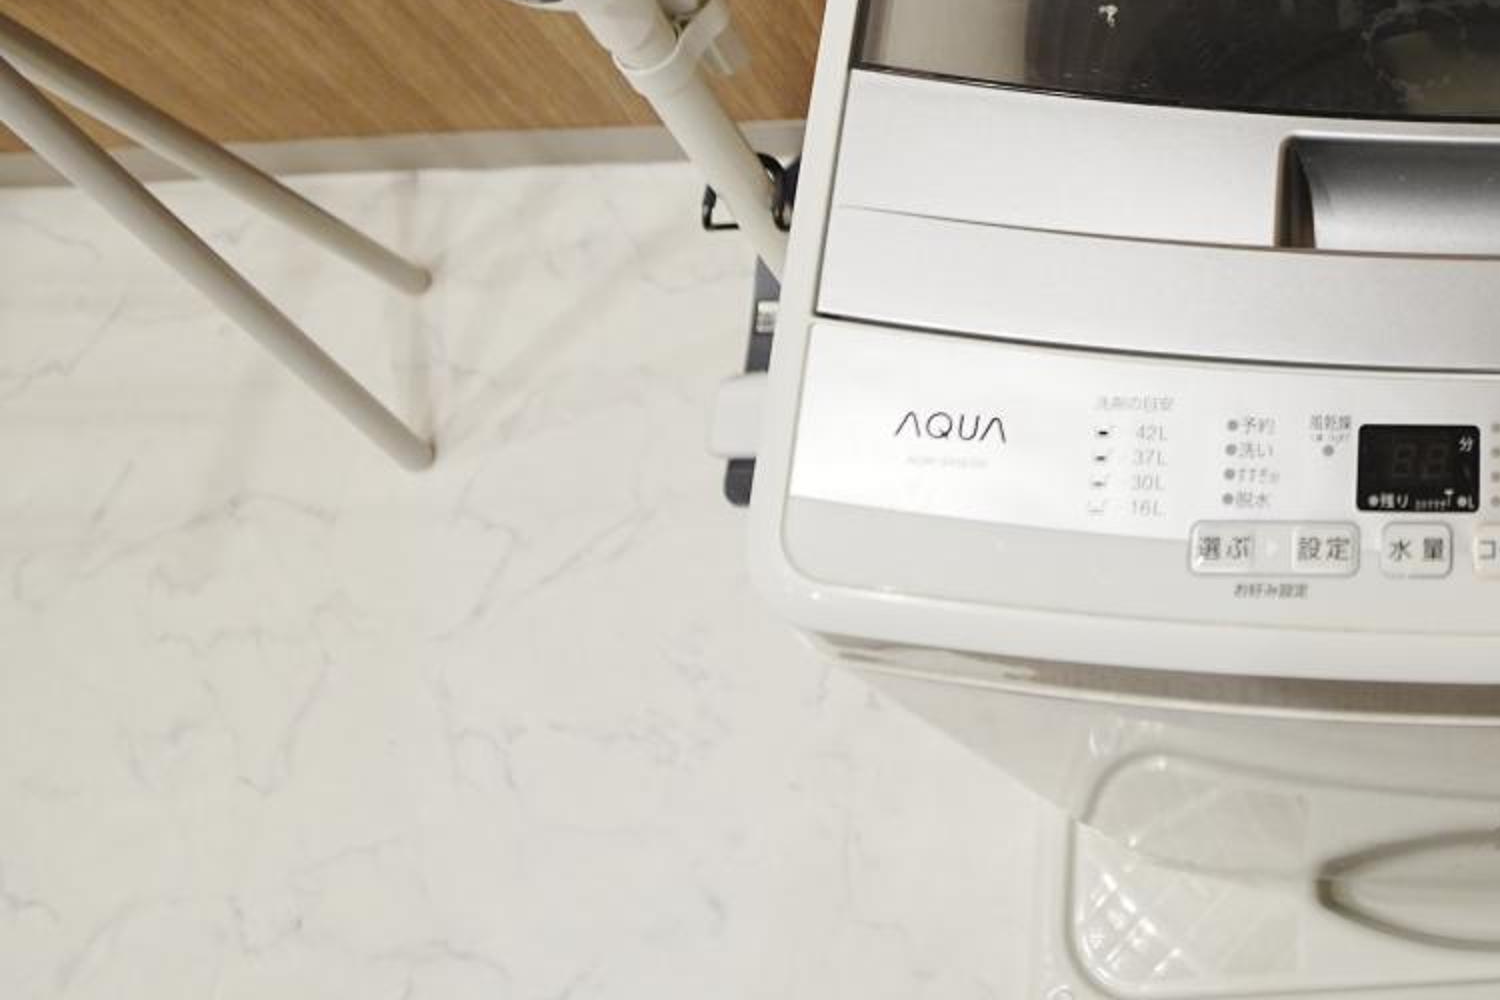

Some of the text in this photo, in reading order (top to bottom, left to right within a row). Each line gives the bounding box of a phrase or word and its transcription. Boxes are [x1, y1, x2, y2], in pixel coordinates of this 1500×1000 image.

[894, 411, 1007, 443] AQUA
[1135, 424, 1168, 441] 42L
[1239, 415, 1276, 436] 予約
[1459, 436, 1473, 452] 分
[1133, 449, 1167, 466] 37L
[1132, 473, 1164, 491] 30L
[1131, 498, 1163, 517] 16L
[1381, 492, 1409, 509] 残り
[1199, 536, 1350, 561] 選ぶ 設定
[1388, 537, 1443, 562] 水量
